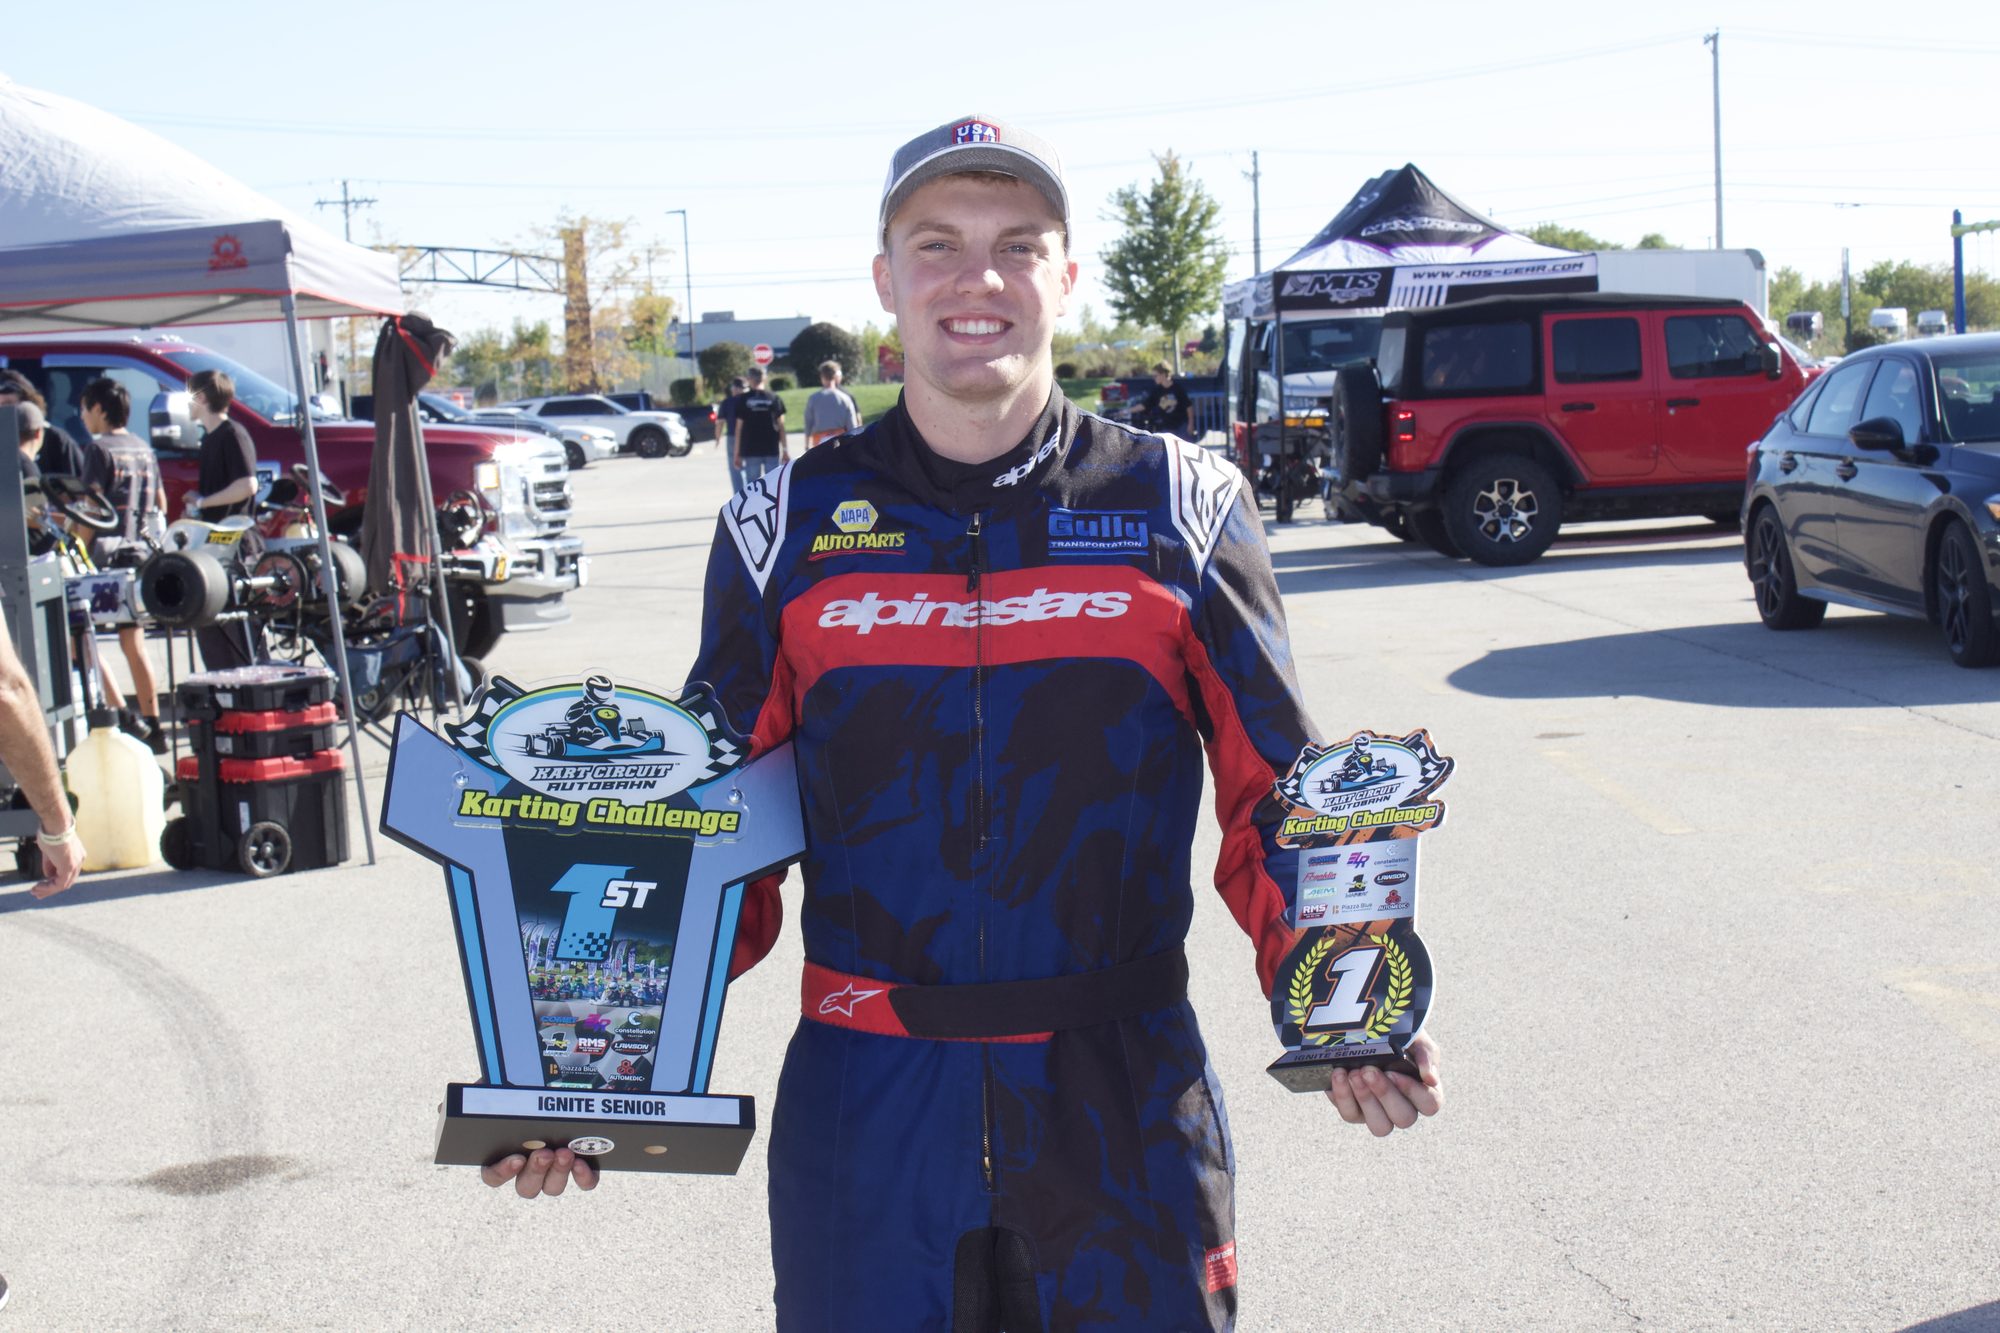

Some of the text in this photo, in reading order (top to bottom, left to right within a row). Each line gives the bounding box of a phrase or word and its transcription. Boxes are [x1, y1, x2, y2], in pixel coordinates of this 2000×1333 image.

[957, 124, 996, 137] USA
[841, 508, 869, 523] NAPA
[1048, 513, 1149, 547] Gully
[812, 532, 905, 552] AUTO PARTS
[818, 588, 1132, 634] alpinestars
[530, 763, 674, 781] KART CIRCUIT
[546, 780, 657, 791] AUTOBAHN
[1322, 783, 1401, 808] KART CIRCUIT
[1331, 795, 1391, 812] AUTOBAHN
[459, 791, 739, 834] Karting Challenge
[1283, 806, 1437, 835] Karting Challenge
[1377, 872, 1407, 881] LAWSON
[1303, 904, 1326, 914] RMS
[1304, 946, 1384, 1031] 1
[578, 1037, 606, 1048] RMS
[1294, 1052, 1331, 1061] IGNITE
[1335, 1048, 1377, 1058] SENIOR
[538, 1096, 666, 1116] IGNITE SENIOR
